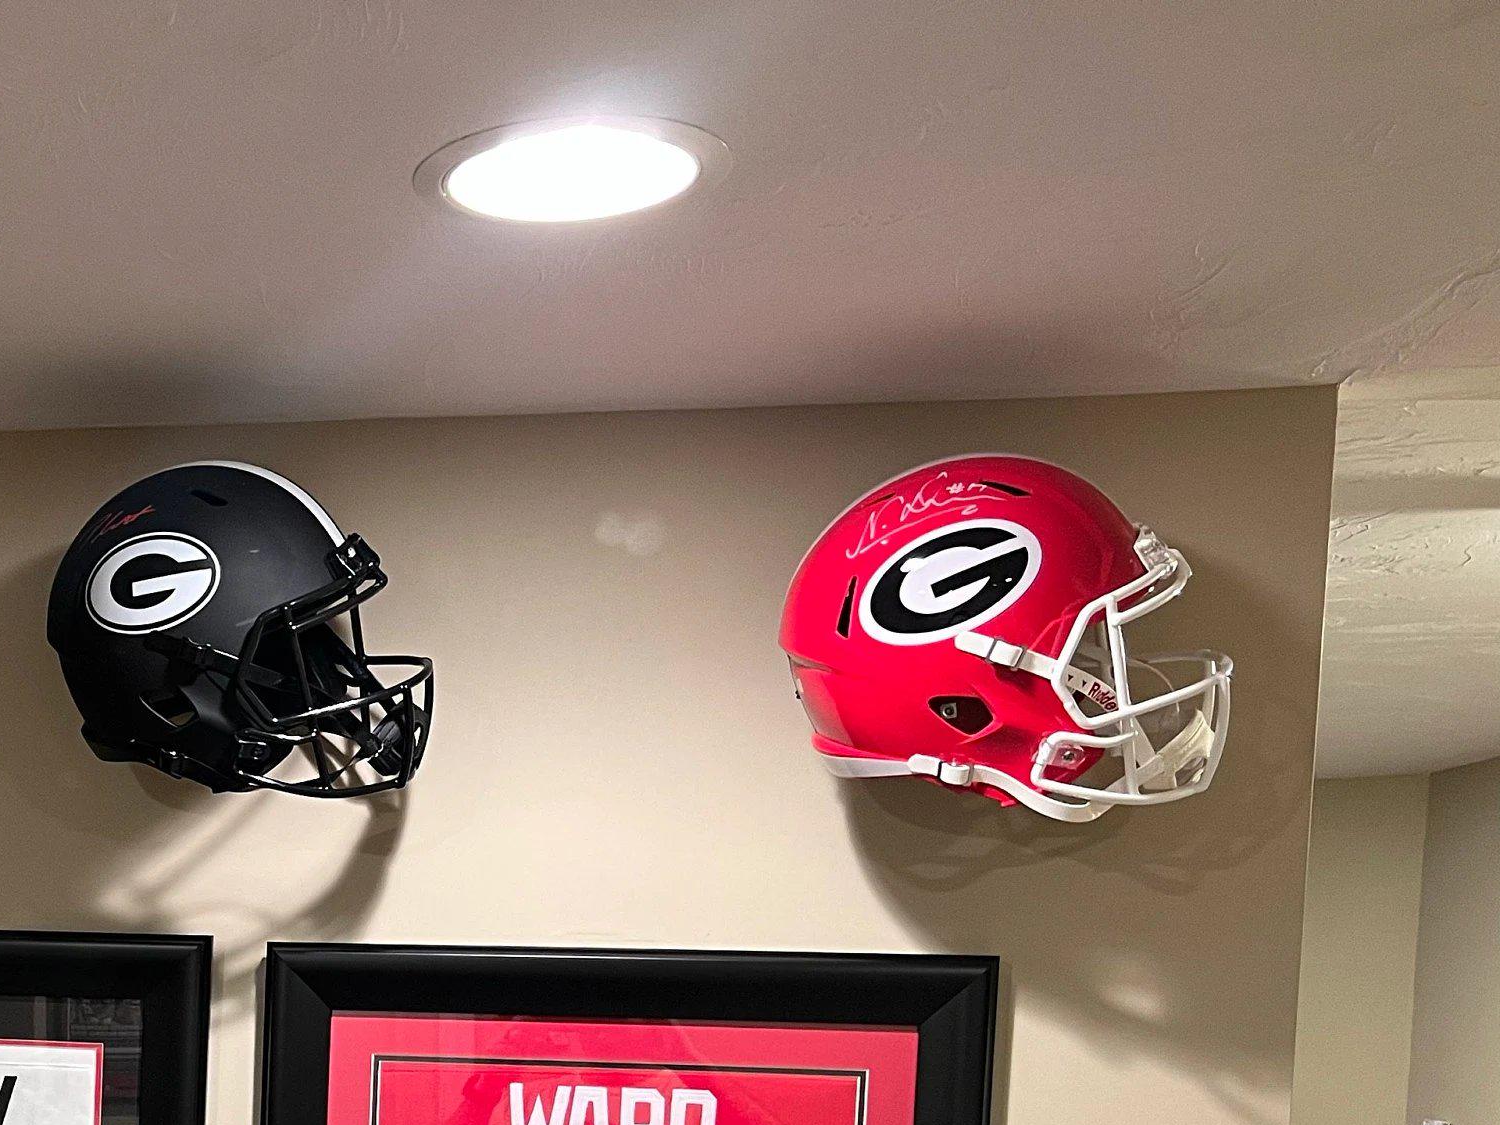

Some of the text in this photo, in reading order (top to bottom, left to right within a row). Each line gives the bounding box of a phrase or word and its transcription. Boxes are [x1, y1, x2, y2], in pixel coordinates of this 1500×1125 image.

[89, 537, 213, 627] G
[869, 526, 1029, 635] G
[1088, 681, 1119, 711] Ridde
